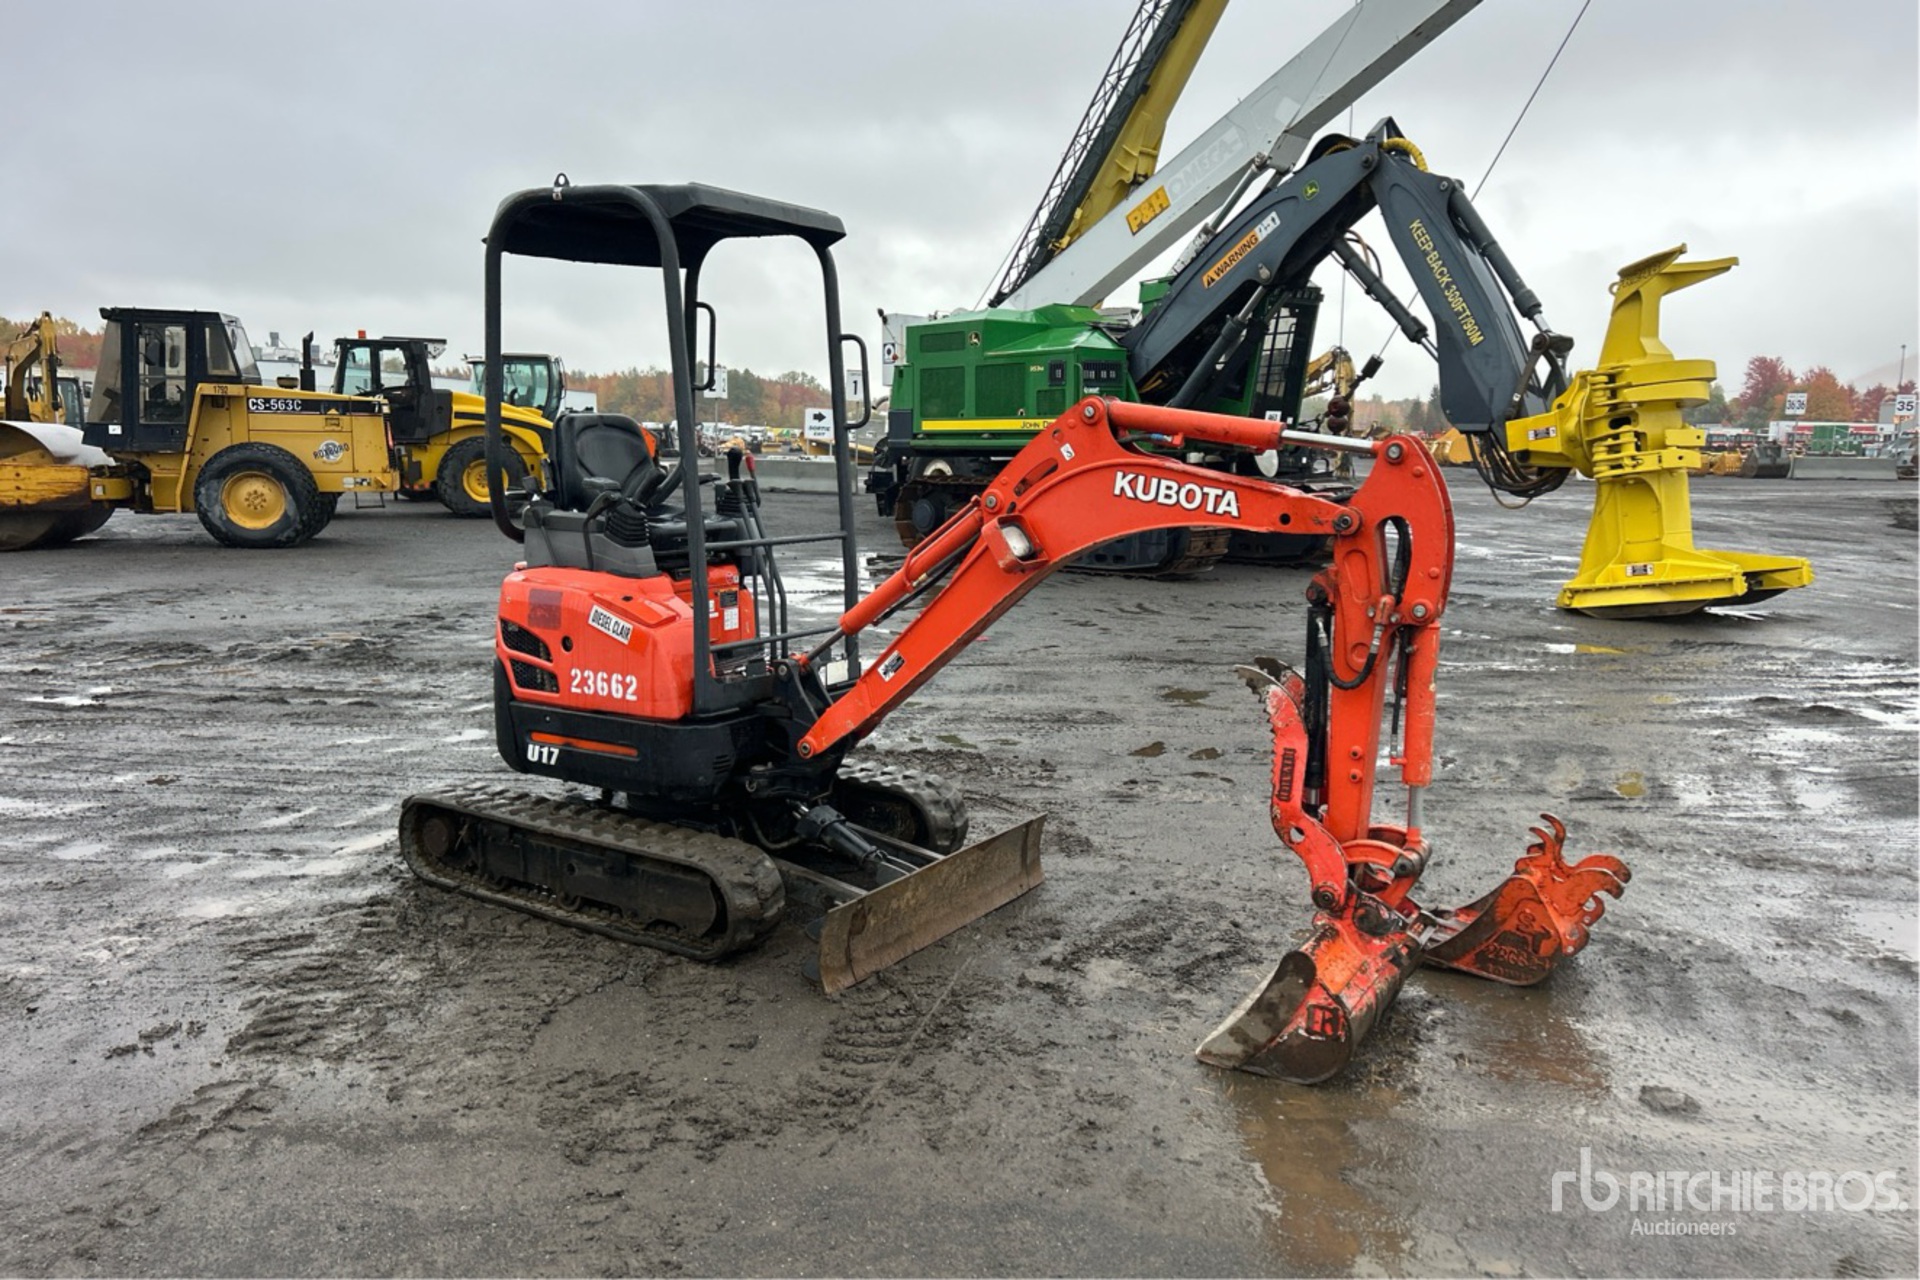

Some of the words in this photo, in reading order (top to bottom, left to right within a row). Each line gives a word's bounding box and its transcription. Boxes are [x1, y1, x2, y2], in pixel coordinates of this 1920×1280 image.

[1129, 188, 1168, 232] P&H
[1214, 234, 1259, 278] WARNING
[1409, 219, 1434, 251] KEEP
[1426, 251, 1452, 288] BACK
[852, 380, 858, 395] 1
[249, 399, 302, 411] CS-563C
[1897, 401, 1914, 412] 35
[1021, 421, 1040, 429] JOHN
[1113, 470, 1240, 519] KUBOTA
[591, 608, 613, 633] DIESEL
[611, 620, 632, 642] CLAIR
[571, 667, 638, 701] 23662
[527, 743, 560, 766] U17
